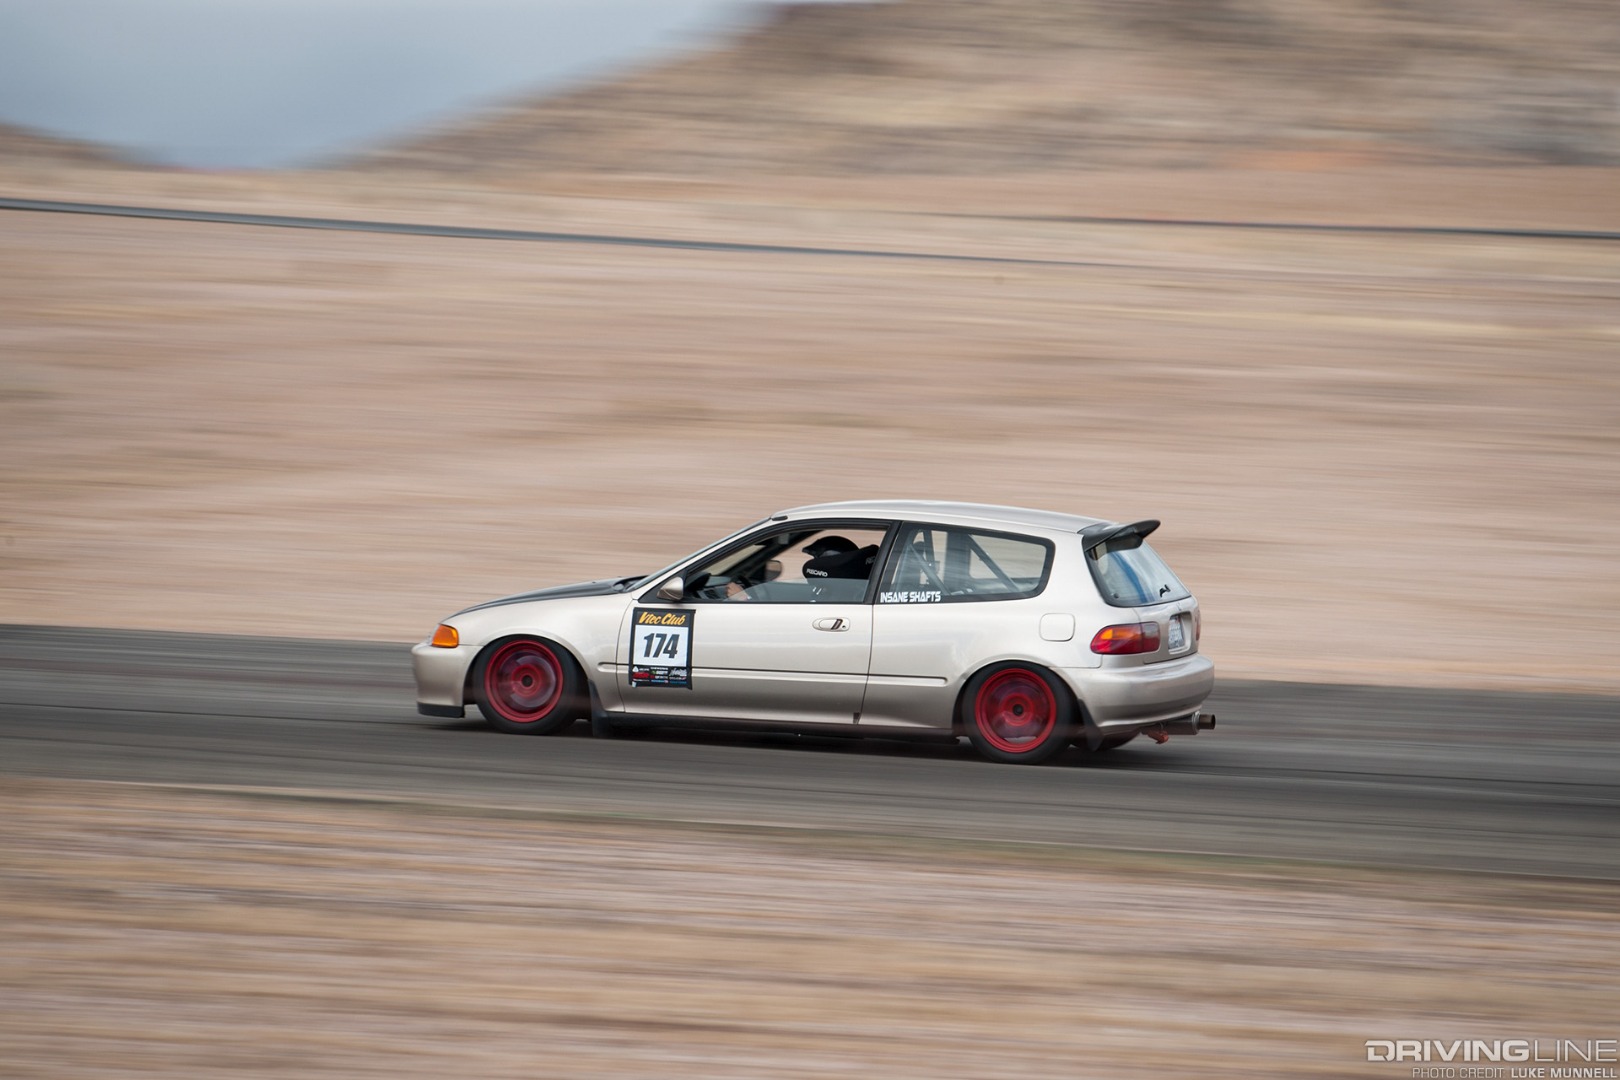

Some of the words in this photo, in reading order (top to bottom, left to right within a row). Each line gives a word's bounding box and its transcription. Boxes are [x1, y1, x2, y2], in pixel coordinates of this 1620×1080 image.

[880, 591, 908, 603] INSANE
[909, 591, 941, 603] SHAFTS
[638, 611, 662, 625] Vtec
[661, 613, 686, 625] Club
[643, 632, 680, 659] 174
